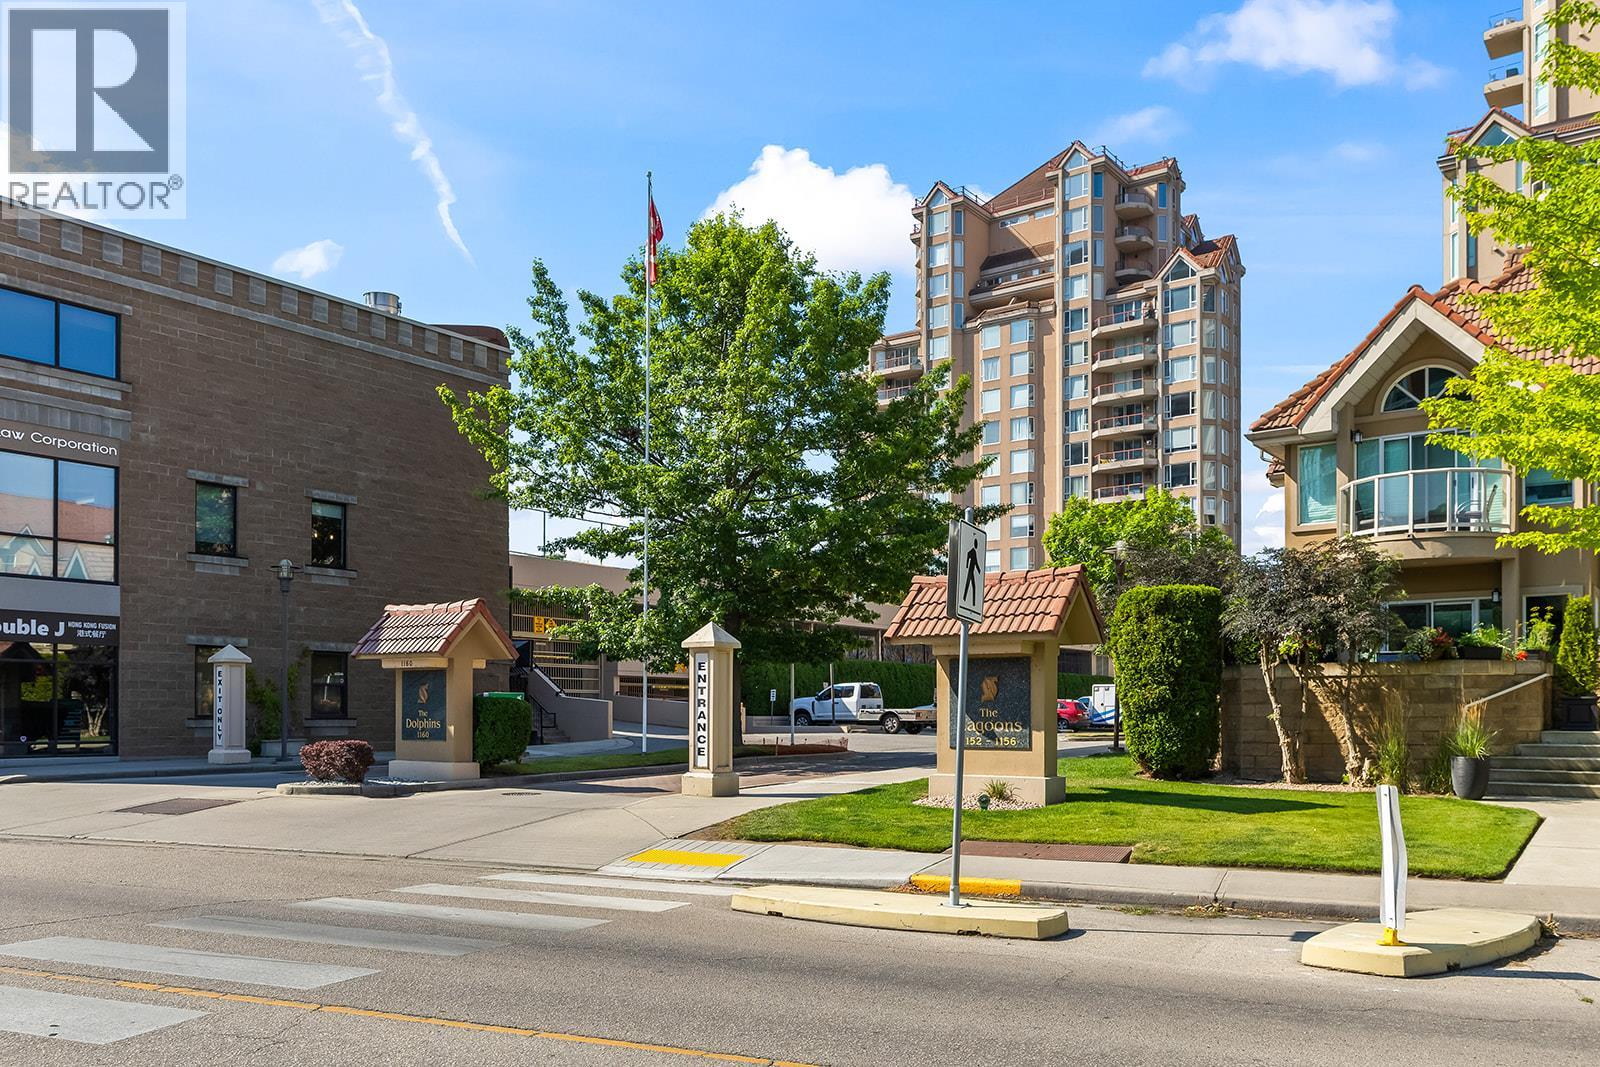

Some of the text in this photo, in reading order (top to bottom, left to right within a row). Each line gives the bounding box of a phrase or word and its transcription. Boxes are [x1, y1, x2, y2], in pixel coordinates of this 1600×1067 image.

[0, 429, 117, 455] aw Corporation
[0, 618, 65, 637] uble J
[98, 622, 117, 630] FUSION
[400, 659, 413, 667] 1160
[697, 661, 706, 756] ENTRANCE
[979, 708, 998, 718] The
[406, 718, 440, 730] Dolphins
[964, 720, 1023, 735] agoons
[966, 737, 982, 746] 152
[995, 737, 1017, 746] 1156
